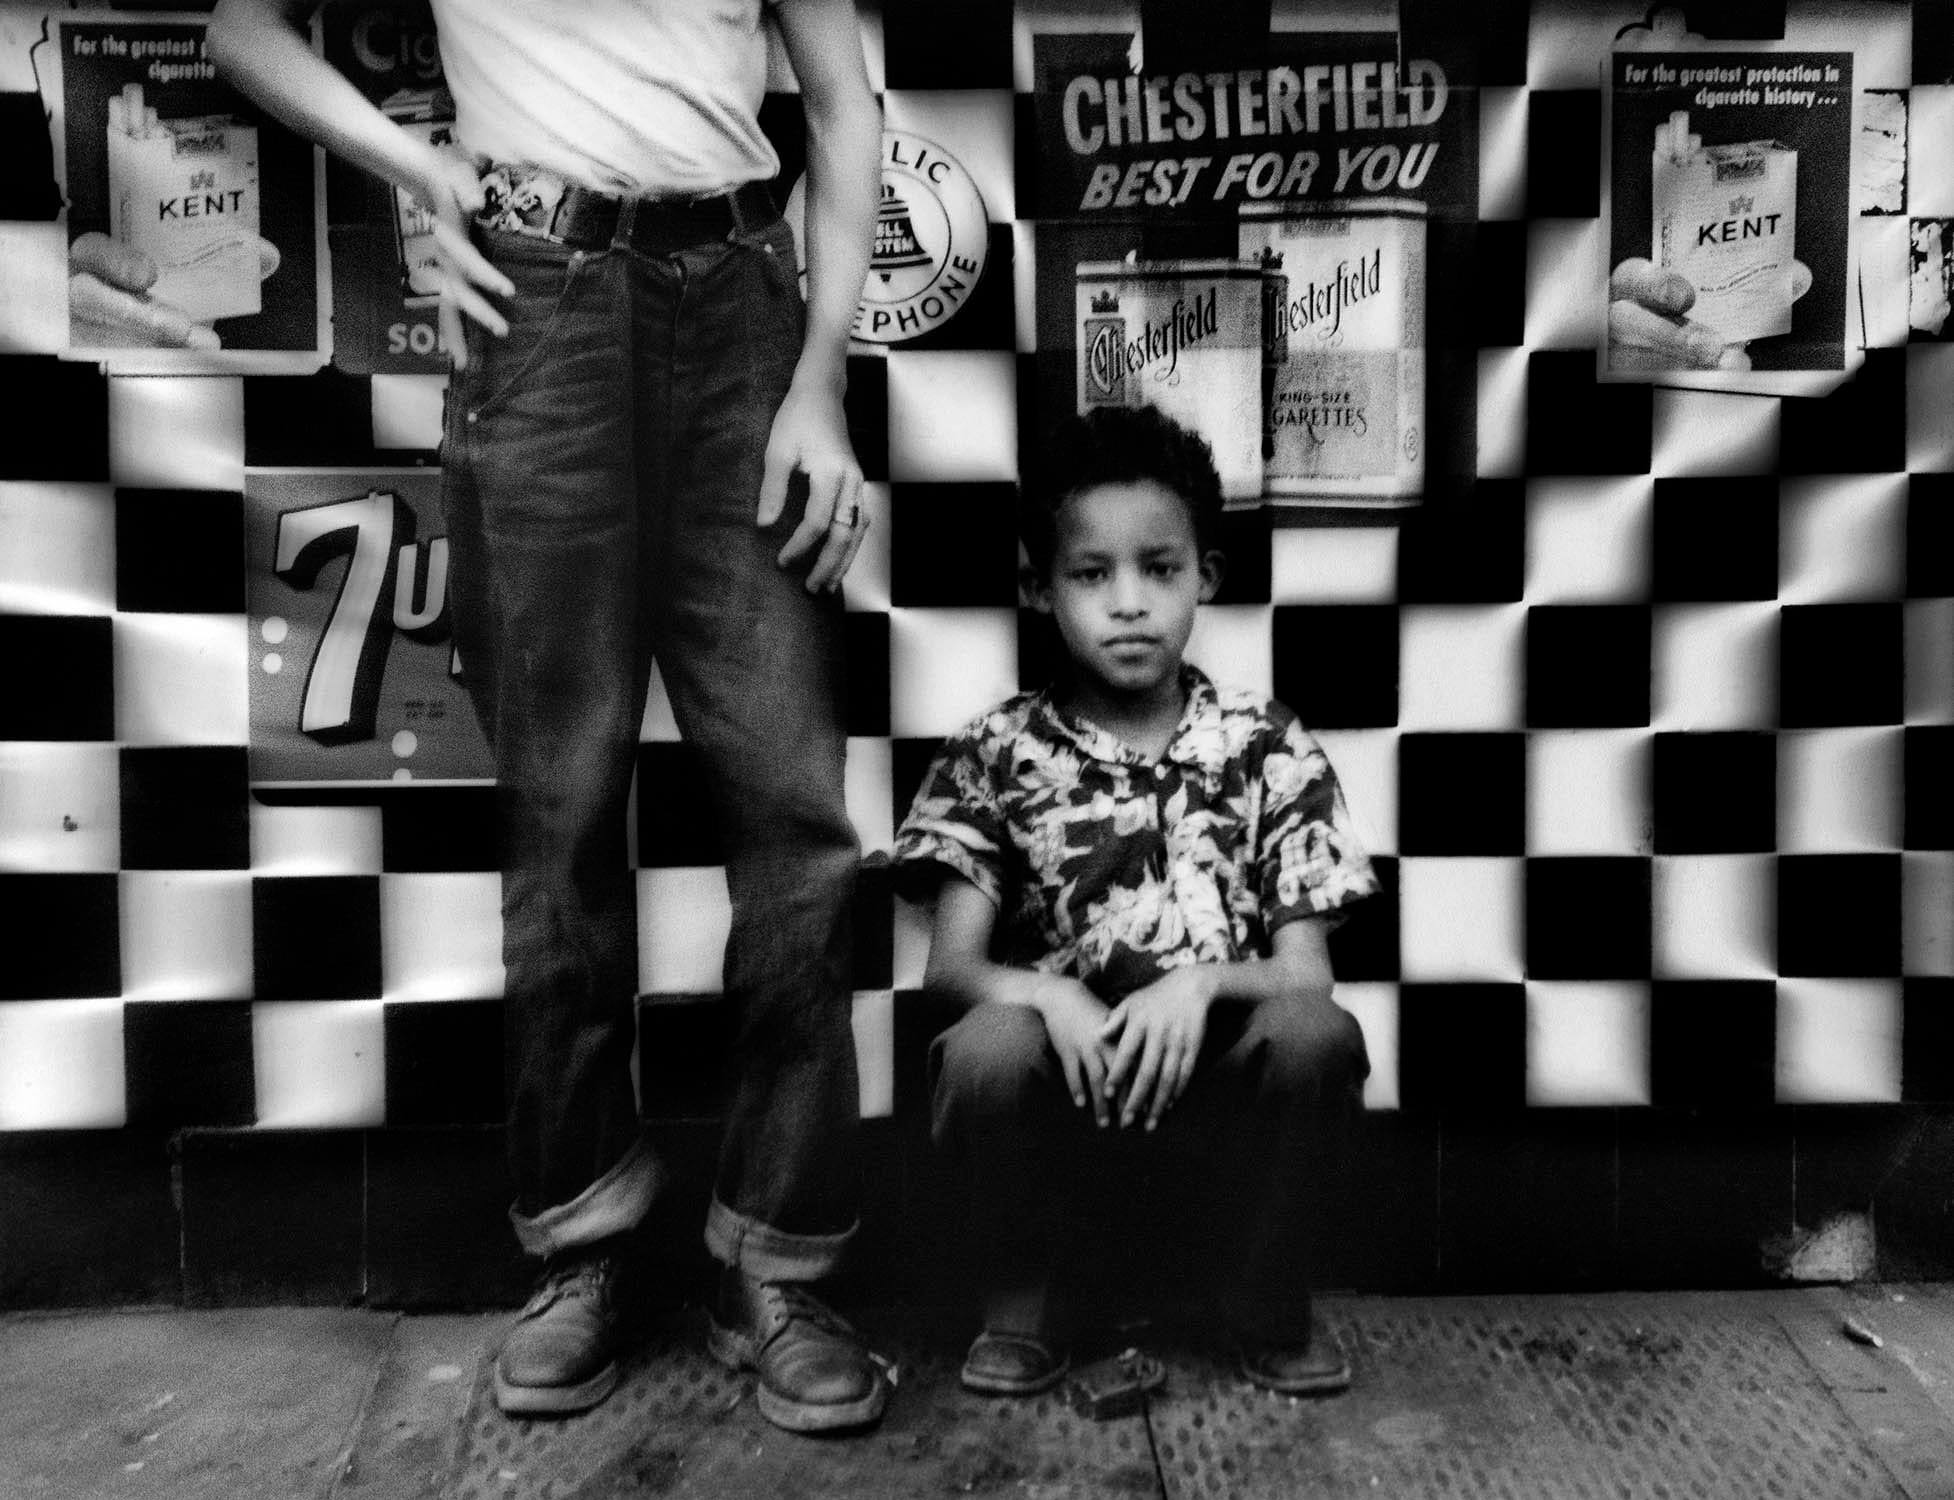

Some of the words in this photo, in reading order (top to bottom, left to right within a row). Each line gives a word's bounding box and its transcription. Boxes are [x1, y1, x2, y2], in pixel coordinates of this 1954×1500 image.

[102, 34, 127, 56] the
[131, 37, 194, 60] greatest
[149, 60, 215, 83] cigarette
[1625, 64, 1648, 83] For
[1652, 63, 1676, 83] the
[1680, 66, 1741, 87] greatest
[1746, 65, 1821, 87] protection
[1825, 64, 1839, 82] in
[1062, 59, 1448, 155] CHESTERFIELD
[1695, 87, 1760, 109] cigarette
[891, 140, 951, 184] LIC
[1080, 156, 1212, 211] BEST
[1213, 151, 1320, 201] FOR
[1333, 142, 1440, 193] YOU
[159, 189, 245, 221] KENT
[874, 236, 914, 254] STEM
[876, 221, 905, 238] ELL
[1698, 213, 1781, 246] KENT
[853, 255, 977, 333] PHONE
[1091, 287, 1217, 394] Chesterfield
[1272, 407, 1367, 444] GARETTES
[275, 490, 462, 734] 7U
